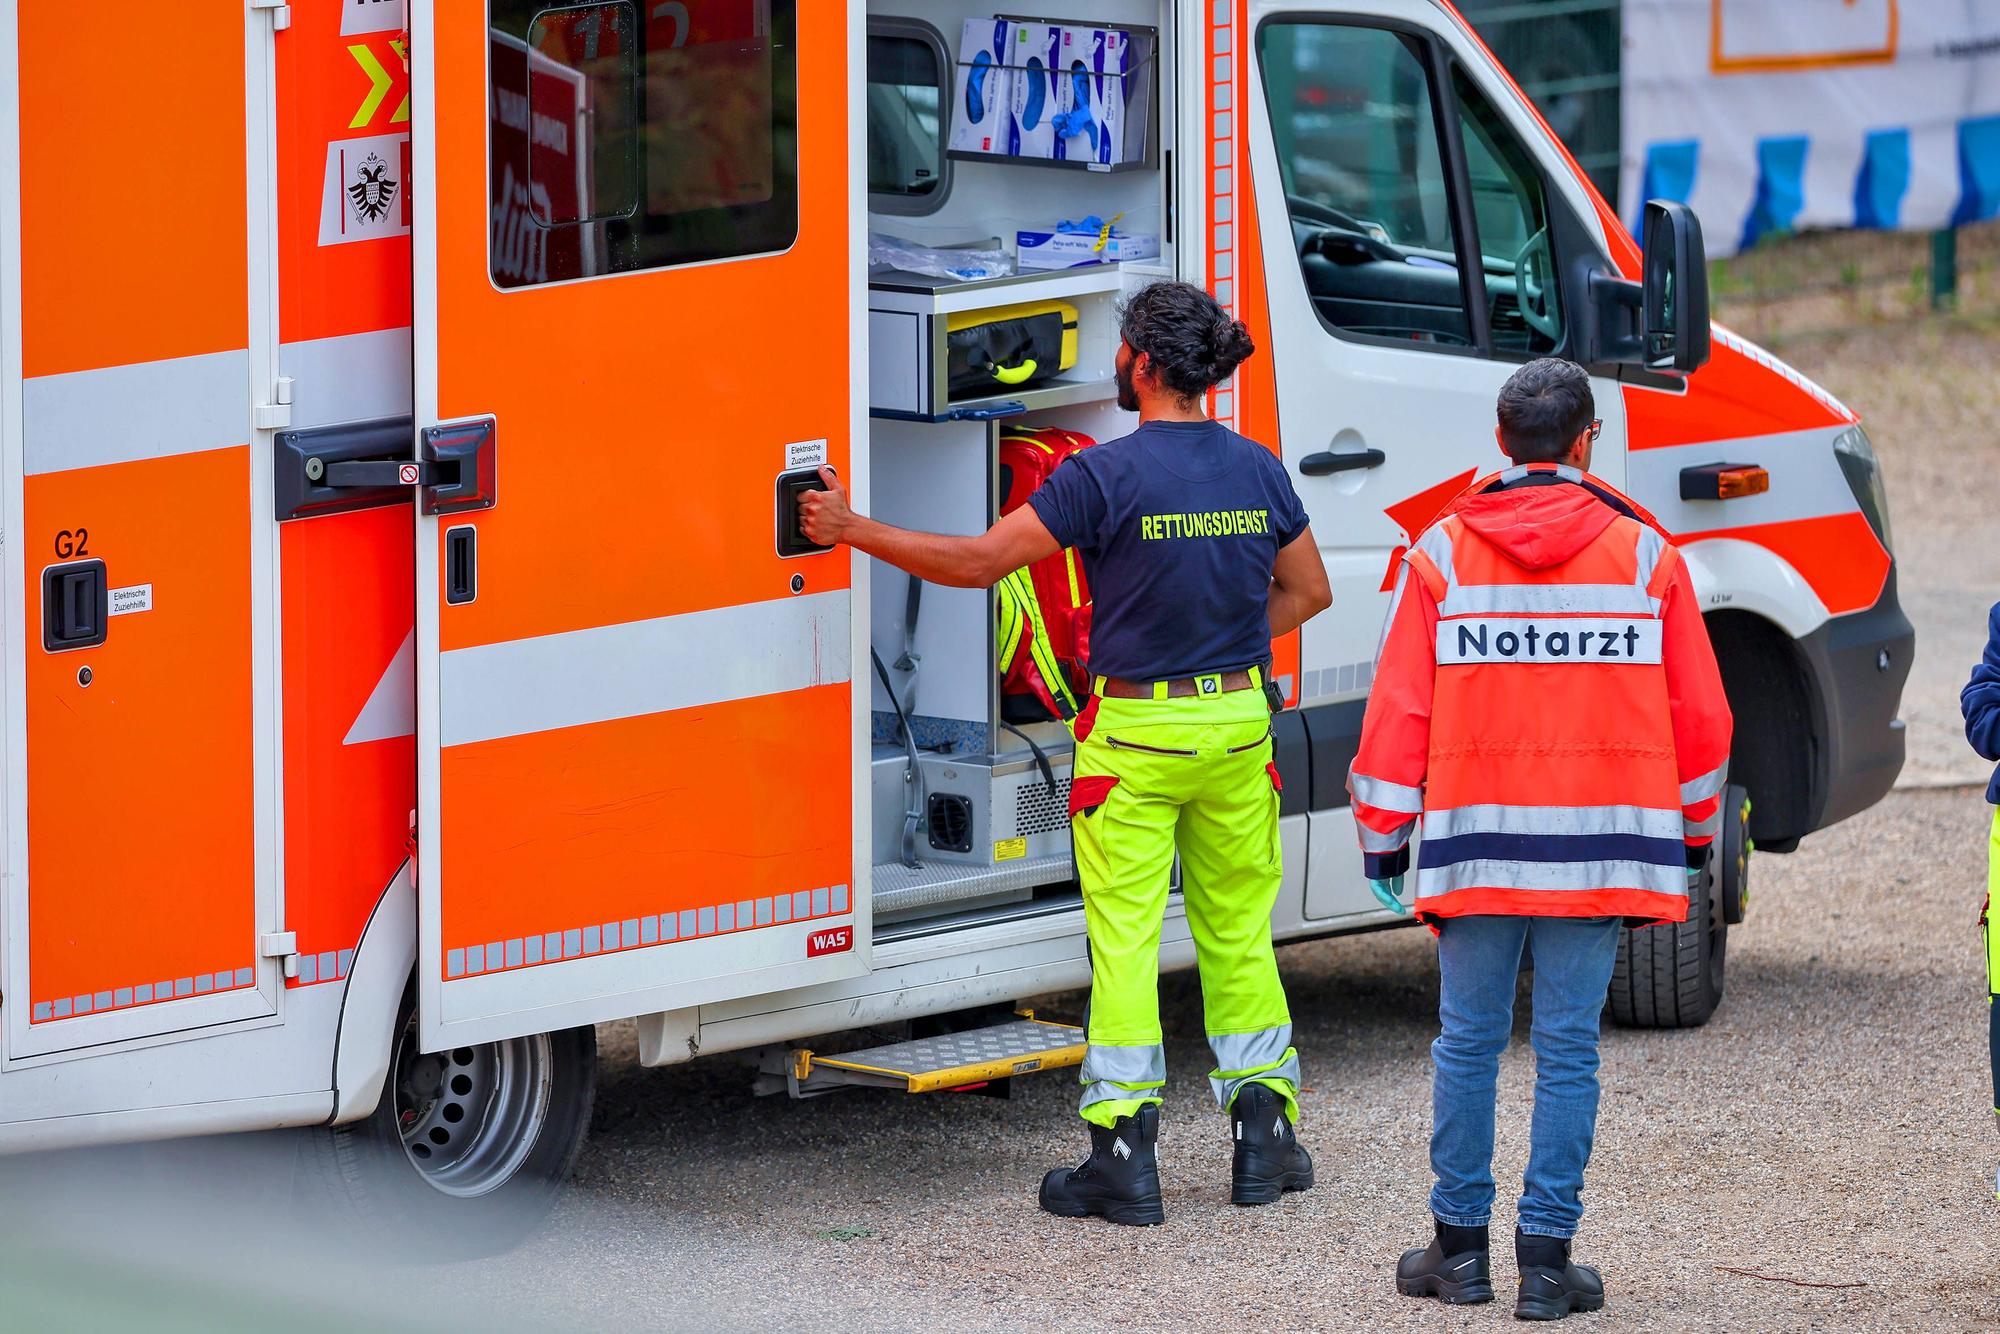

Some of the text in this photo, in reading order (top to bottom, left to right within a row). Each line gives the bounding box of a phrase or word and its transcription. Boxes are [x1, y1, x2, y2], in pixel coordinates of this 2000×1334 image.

[791, 444, 821, 455] Elektrische
[791, 454, 821, 465] Zuziehhilfe
[1141, 509, 1269, 540] RETTUNGSDIENST
[54, 528, 88, 559] G2
[113, 588, 146, 601] Elektrische
[114, 600, 146, 612] Zuziehhilfe
[1458, 624, 1640, 657] Notarzt
[812, 931, 846, 950] WAS
